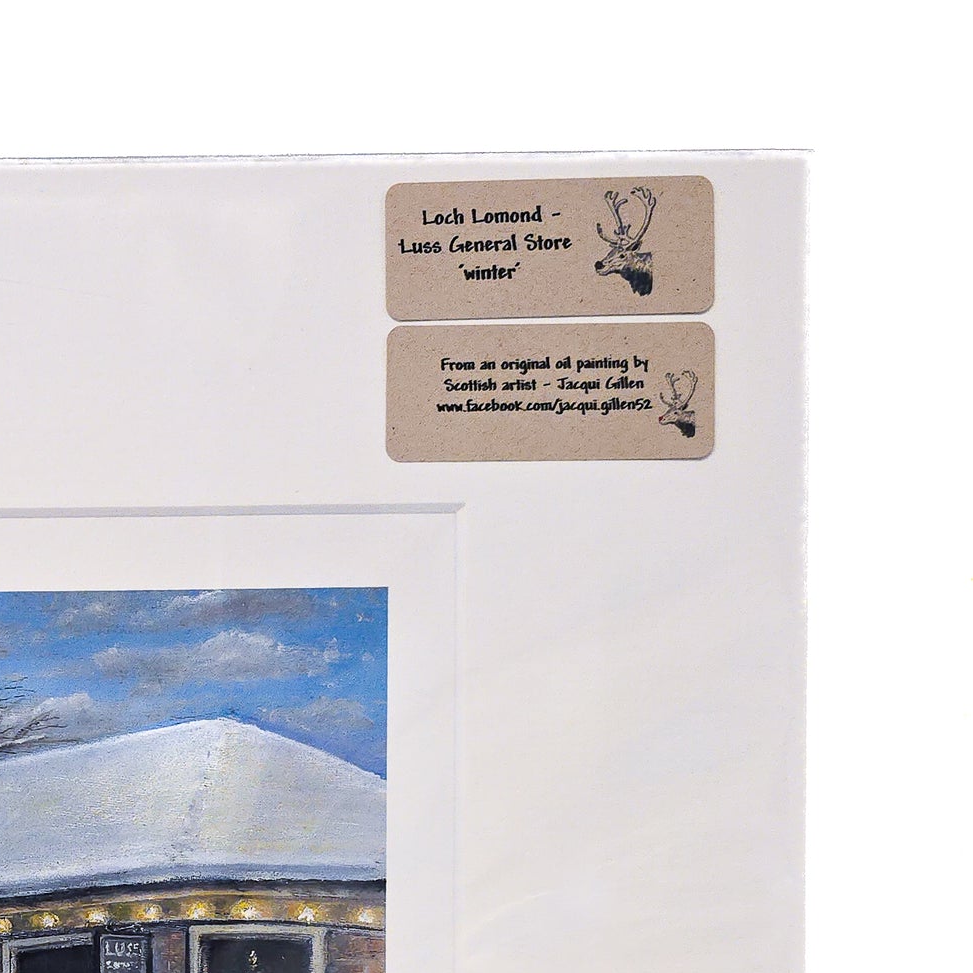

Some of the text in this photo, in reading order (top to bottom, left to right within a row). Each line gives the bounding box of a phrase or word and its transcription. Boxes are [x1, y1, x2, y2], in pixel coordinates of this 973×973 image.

[422, 208, 464, 226] Loch
[471, 205, 543, 224] Lomond
[398, 232, 573, 255] Luss General Store
[440, 355, 649, 374] From an original oil painting by
[443, 378, 497, 392] Scottish
[501, 378, 537, 391] artist
[557, 377, 601, 391] Jacqui
[605, 376, 644, 390] Gillen
[436, 397, 653, 415] www.facebook.com/jacqui.gillen52
